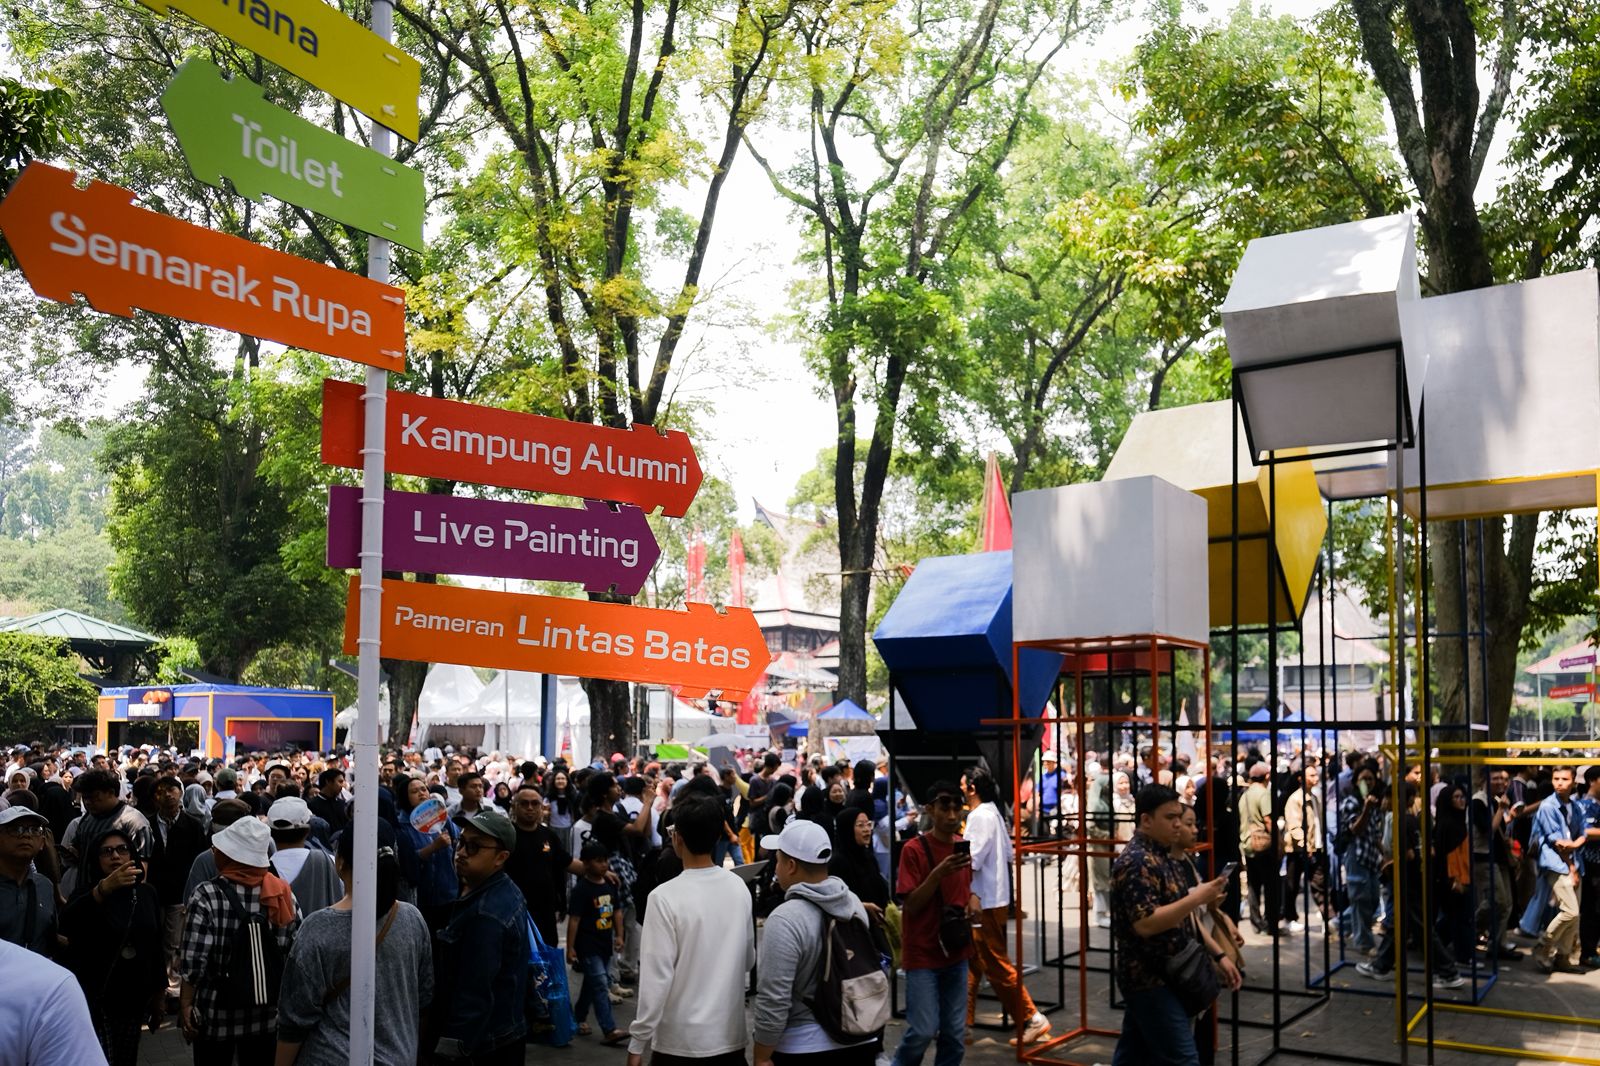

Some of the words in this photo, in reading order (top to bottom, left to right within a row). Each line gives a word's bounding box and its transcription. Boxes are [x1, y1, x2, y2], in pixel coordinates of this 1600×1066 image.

[232, 112, 344, 198] Toilet
[49, 210, 262, 308] Semarak
[271, 275, 372, 338] Rupa
[402, 413, 571, 475] Kampung
[580, 442, 688, 485] Alumni
[414, 511, 495, 547] Live
[504, 520, 639, 568] Painting
[395, 606, 504, 637] Pameran
[517, 615, 635, 657] Lintas
[643, 629, 751, 669] Batas
